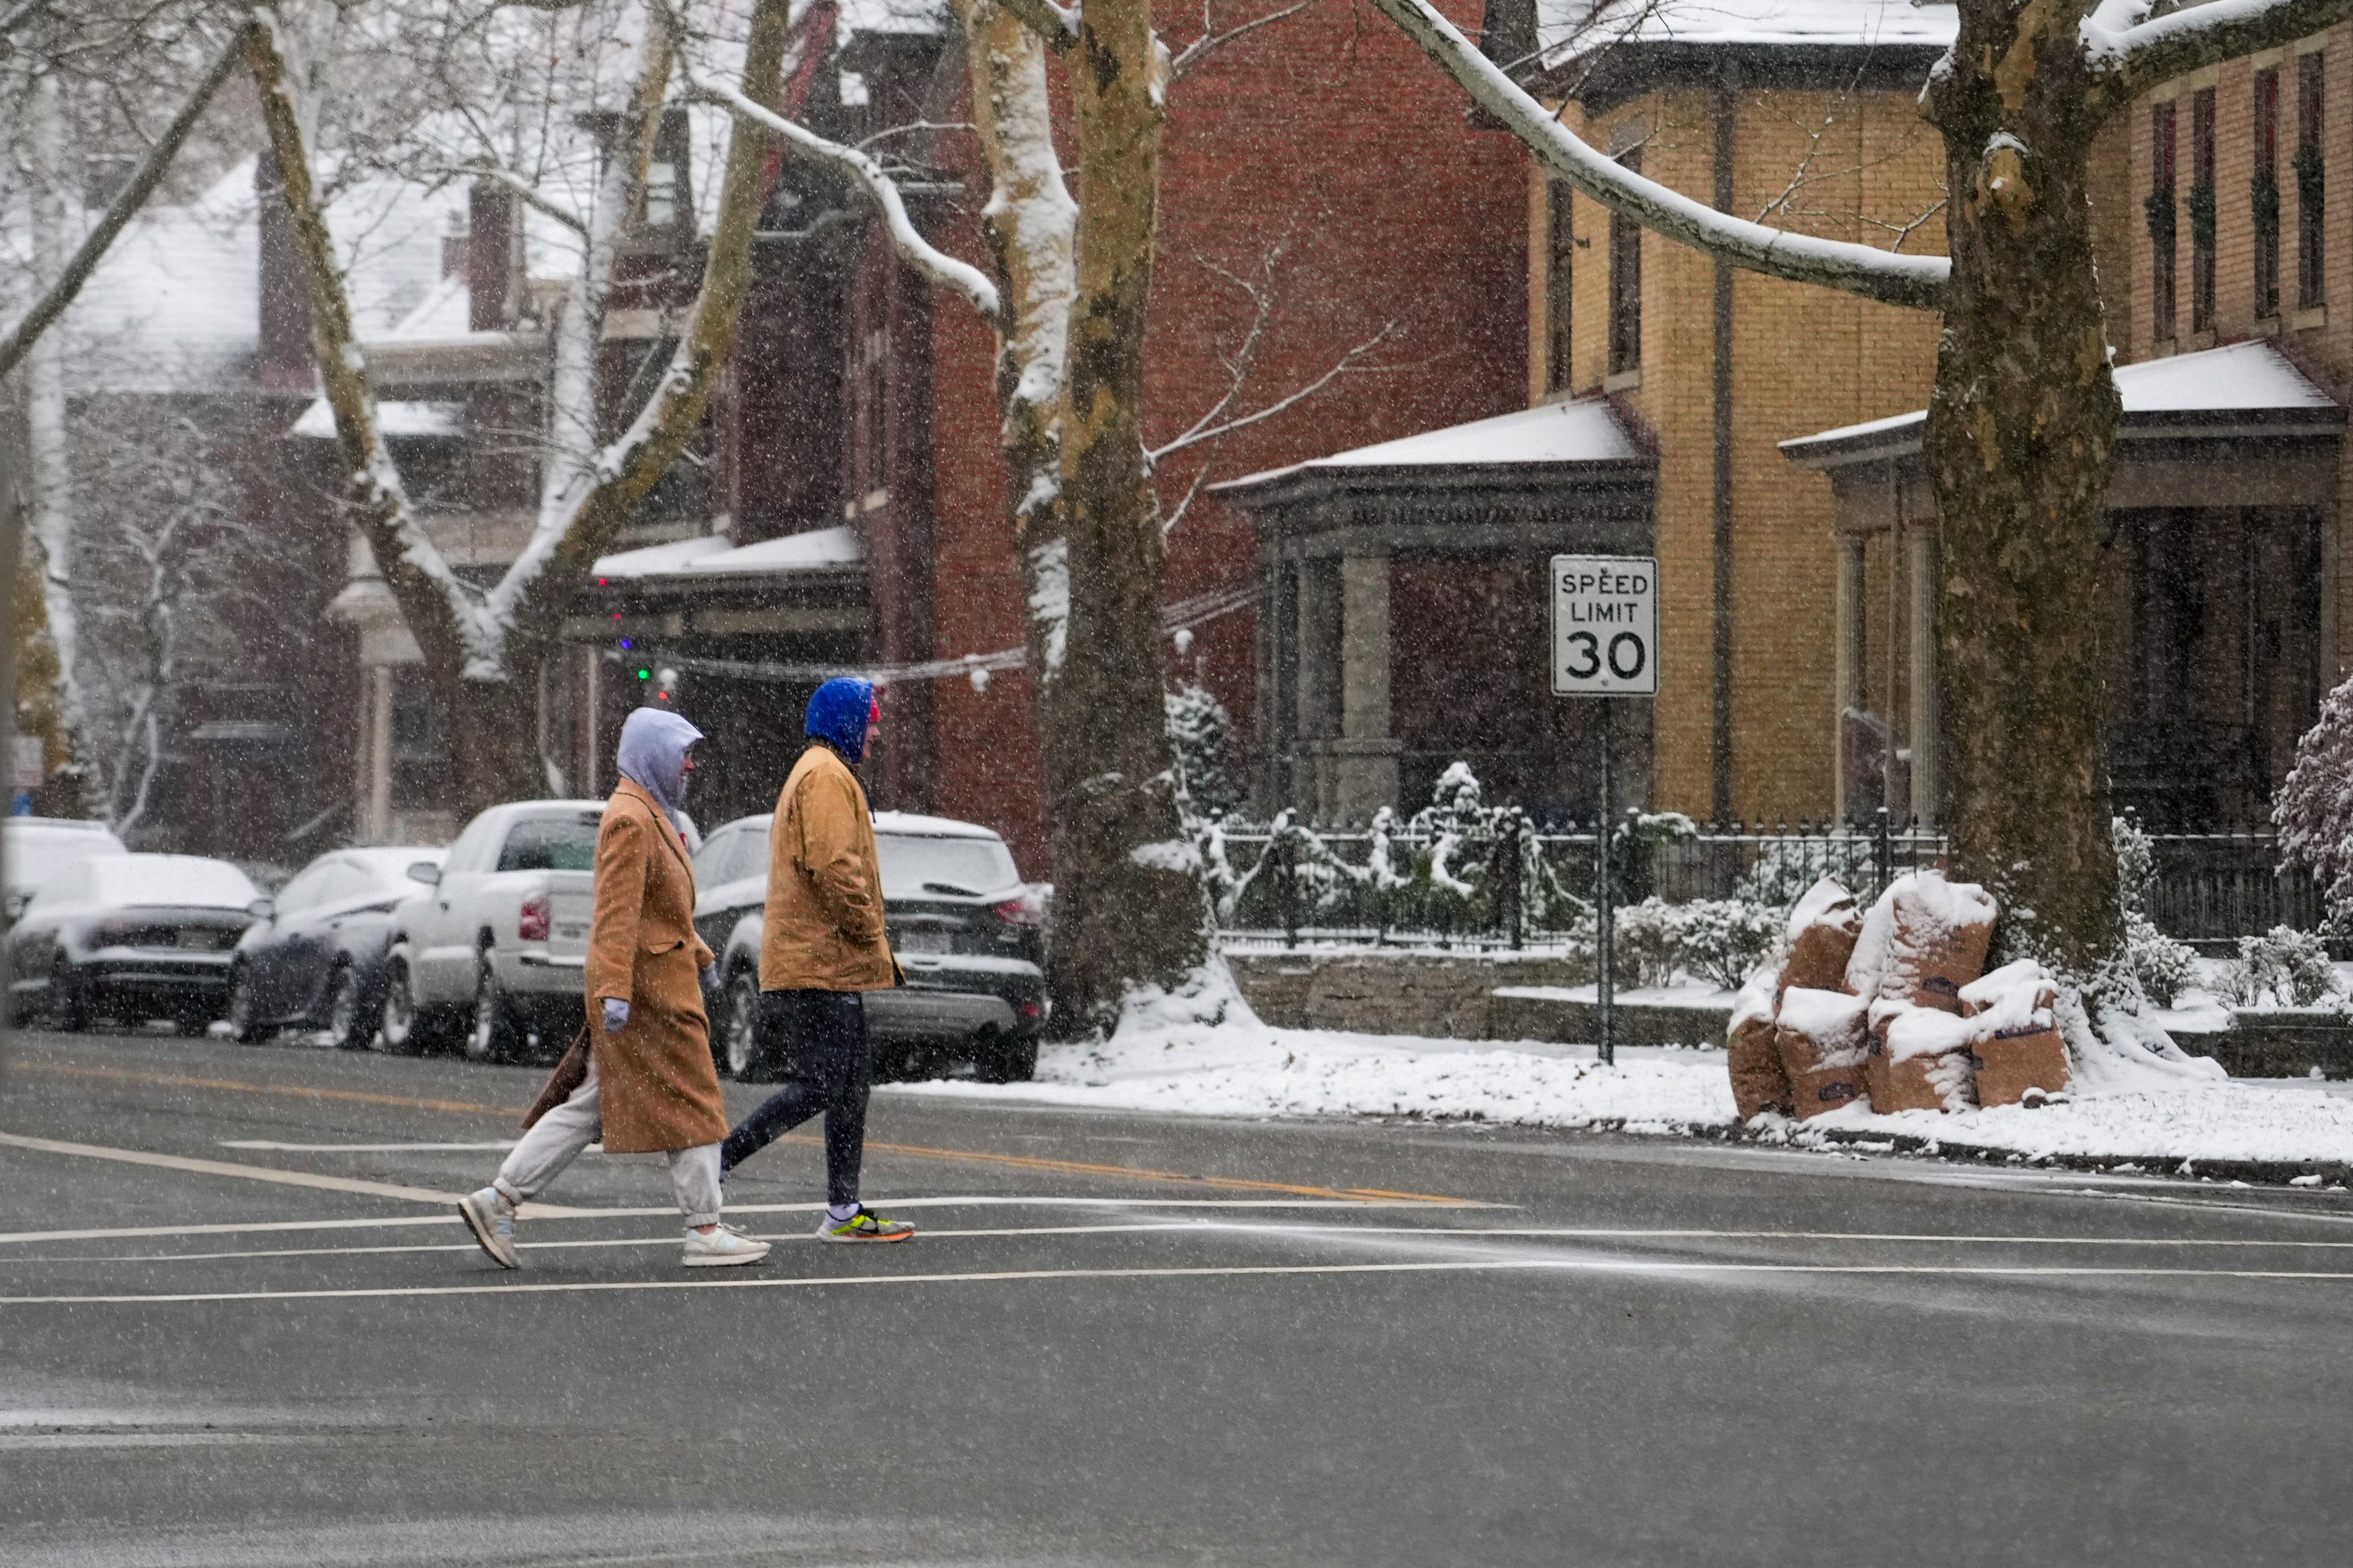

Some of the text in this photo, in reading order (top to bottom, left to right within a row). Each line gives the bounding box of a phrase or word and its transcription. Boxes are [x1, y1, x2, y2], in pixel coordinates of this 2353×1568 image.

[1562, 574, 1648, 595] SPEED
[1571, 601, 1638, 623] LIMIT
[1565, 630, 1646, 680] 30
